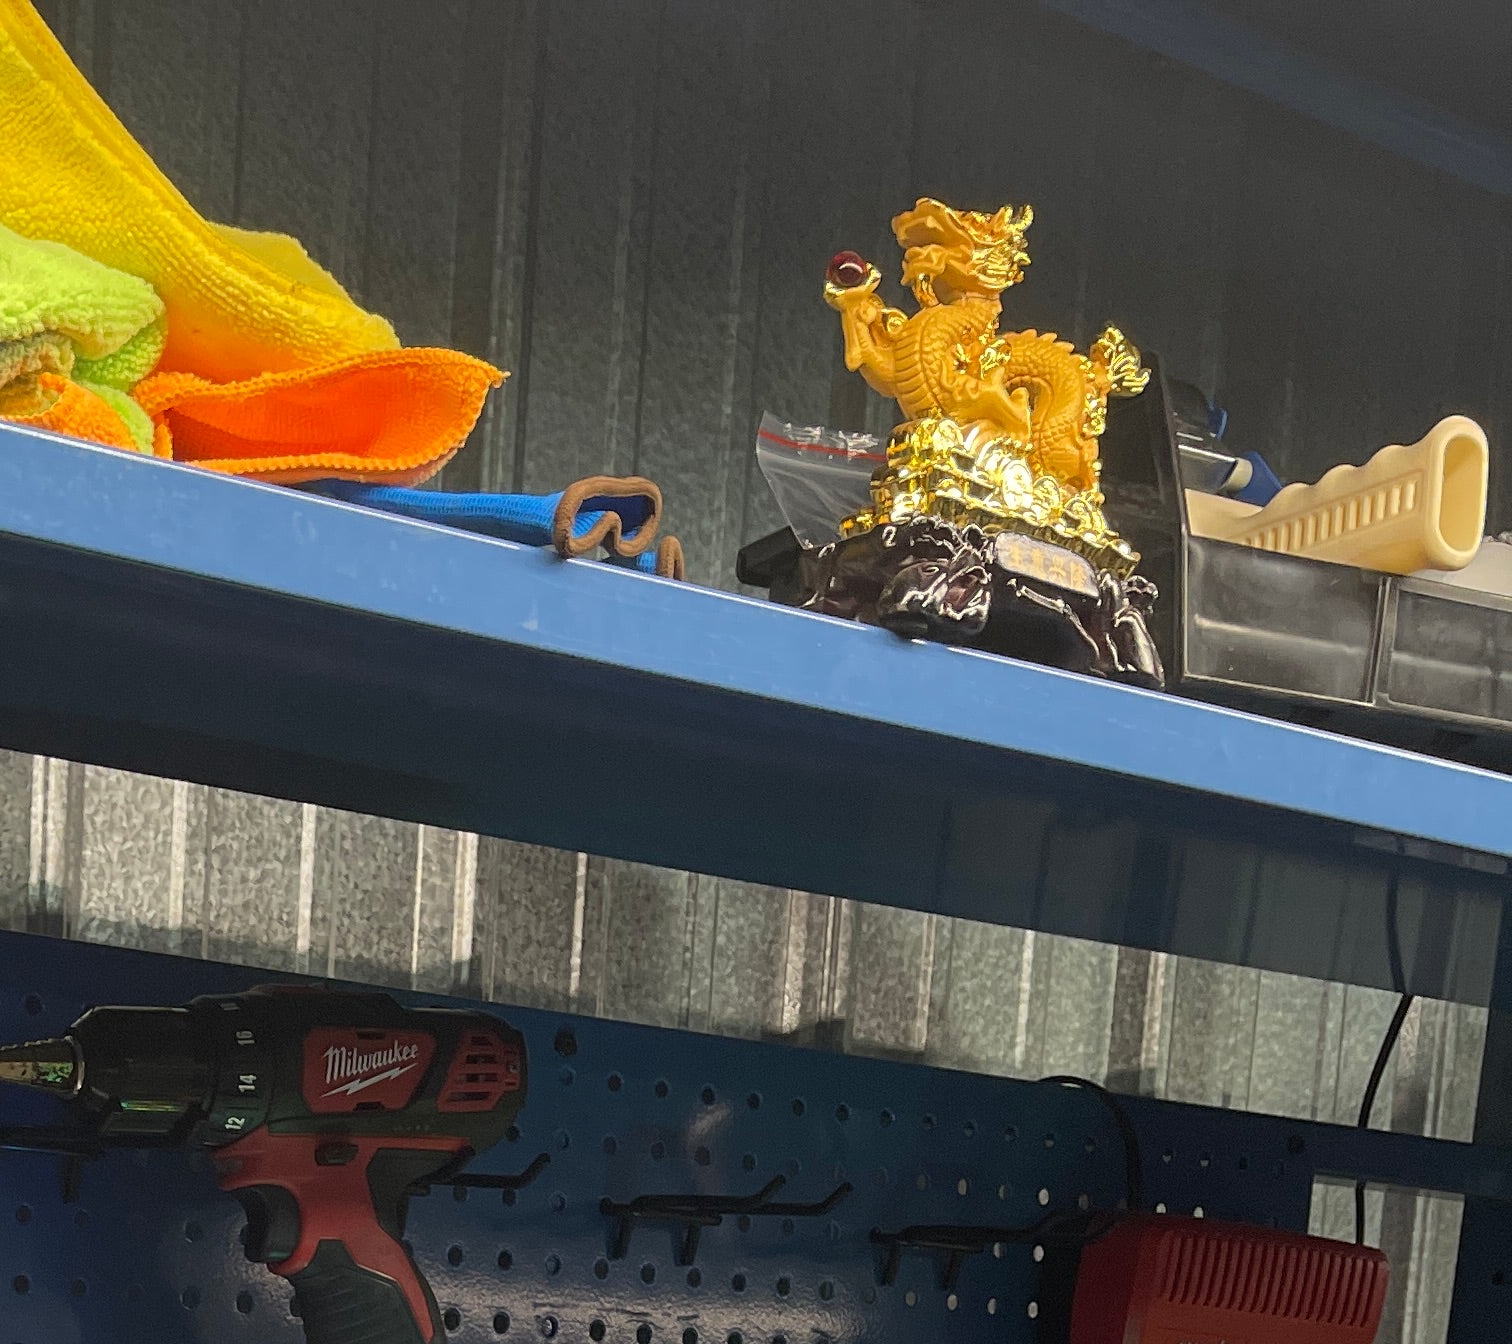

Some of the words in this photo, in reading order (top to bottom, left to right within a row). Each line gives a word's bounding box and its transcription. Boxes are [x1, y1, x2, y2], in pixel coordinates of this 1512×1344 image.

[322, 1040, 419, 1084] Milwaukee
[238, 1074, 257, 1093] 14
[224, 1116, 245, 1130] 12
